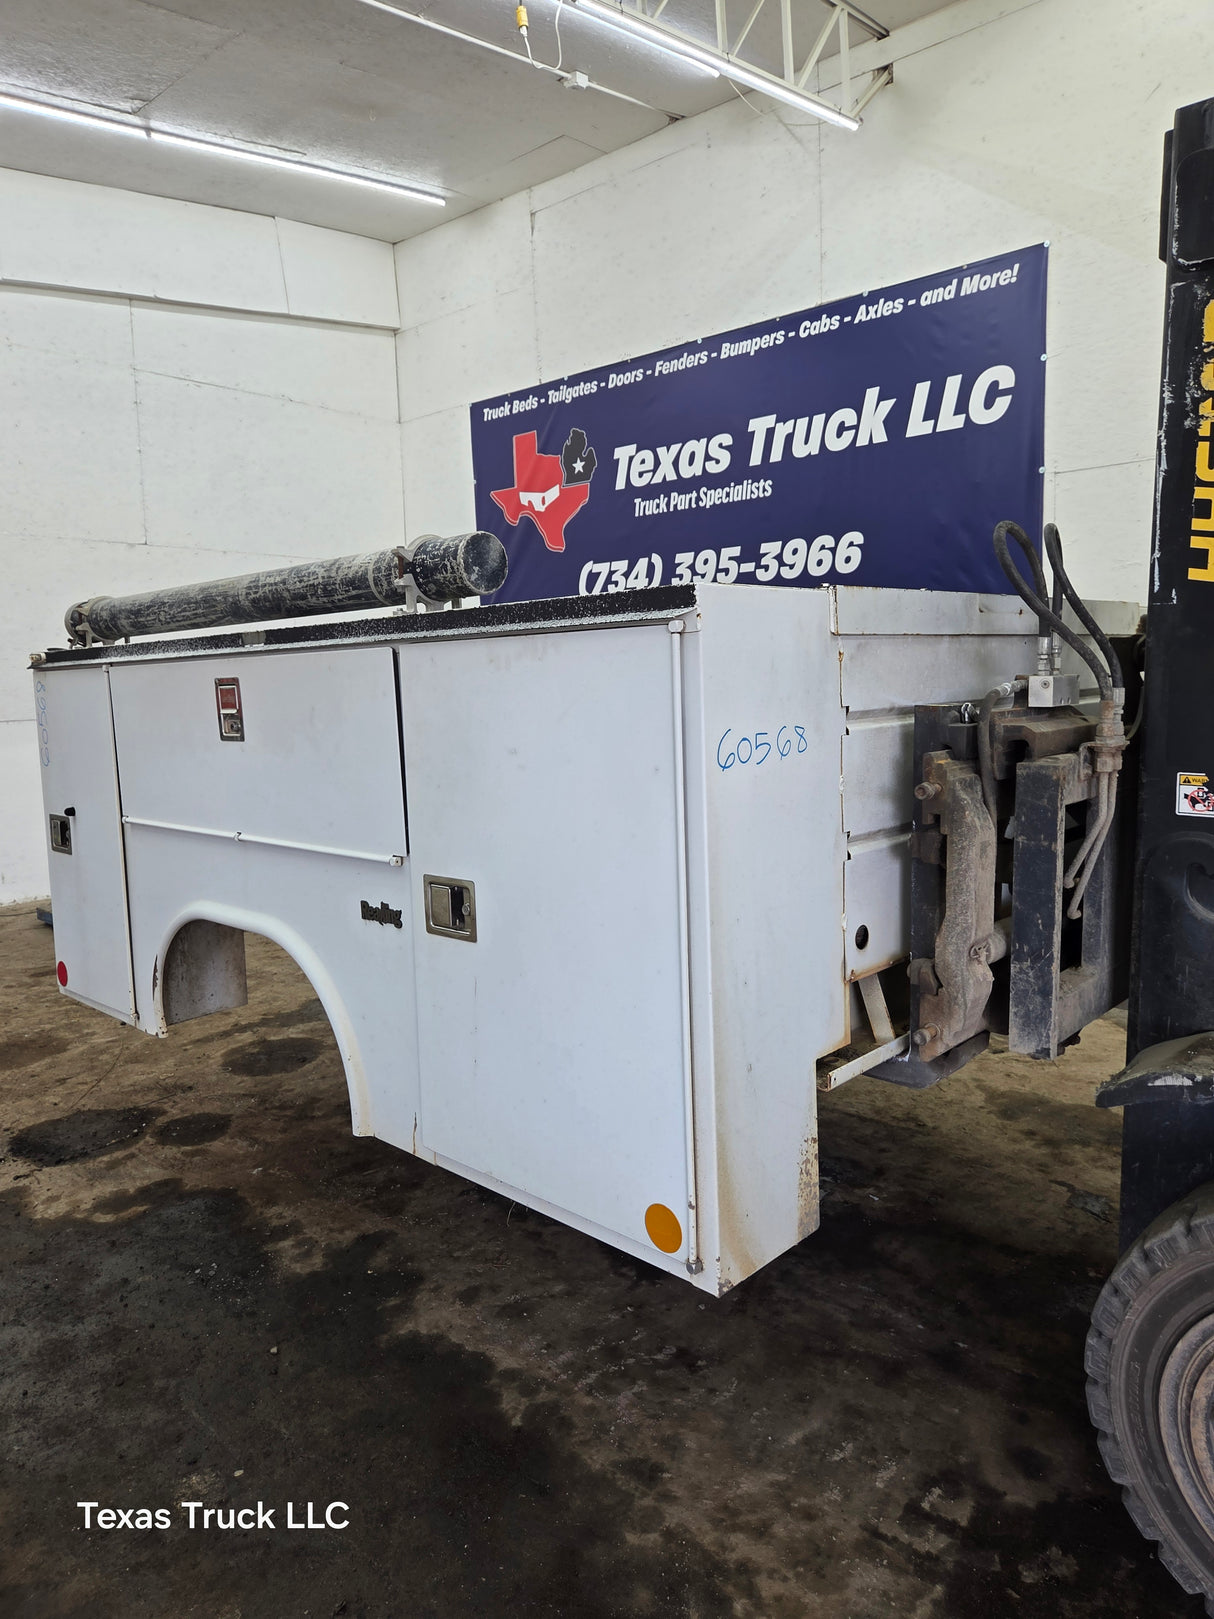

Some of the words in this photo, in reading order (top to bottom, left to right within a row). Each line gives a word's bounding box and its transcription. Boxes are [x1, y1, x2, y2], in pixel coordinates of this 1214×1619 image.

[482, 401, 511, 422] Truck
[511, 394, 539, 415] Beds
[547, 380, 598, 405] Tailgates
[607, 368, 644, 389] Doors
[654, 350, 709, 377] Fenders
[719, 330, 785, 360] Bumpers
[798, 312, 840, 339] Cabs
[853, 297, 905, 325] Axles
[919, 278, 958, 307] and
[960, 262, 1020, 297] More!
[613, 432, 734, 491] Texas
[747, 385, 897, 467] Truck
[905, 364, 1016, 438] LLC
[633, 493, 668, 518] Truck
[669, 490, 698, 513] Part
[698, 478, 773, 509] Specialists
[578, 552, 663, 596] (734)
[670, 530, 865, 586] 395-3966
[35, 680, 50, 767] 60568
[717, 725, 808, 772] 60568
